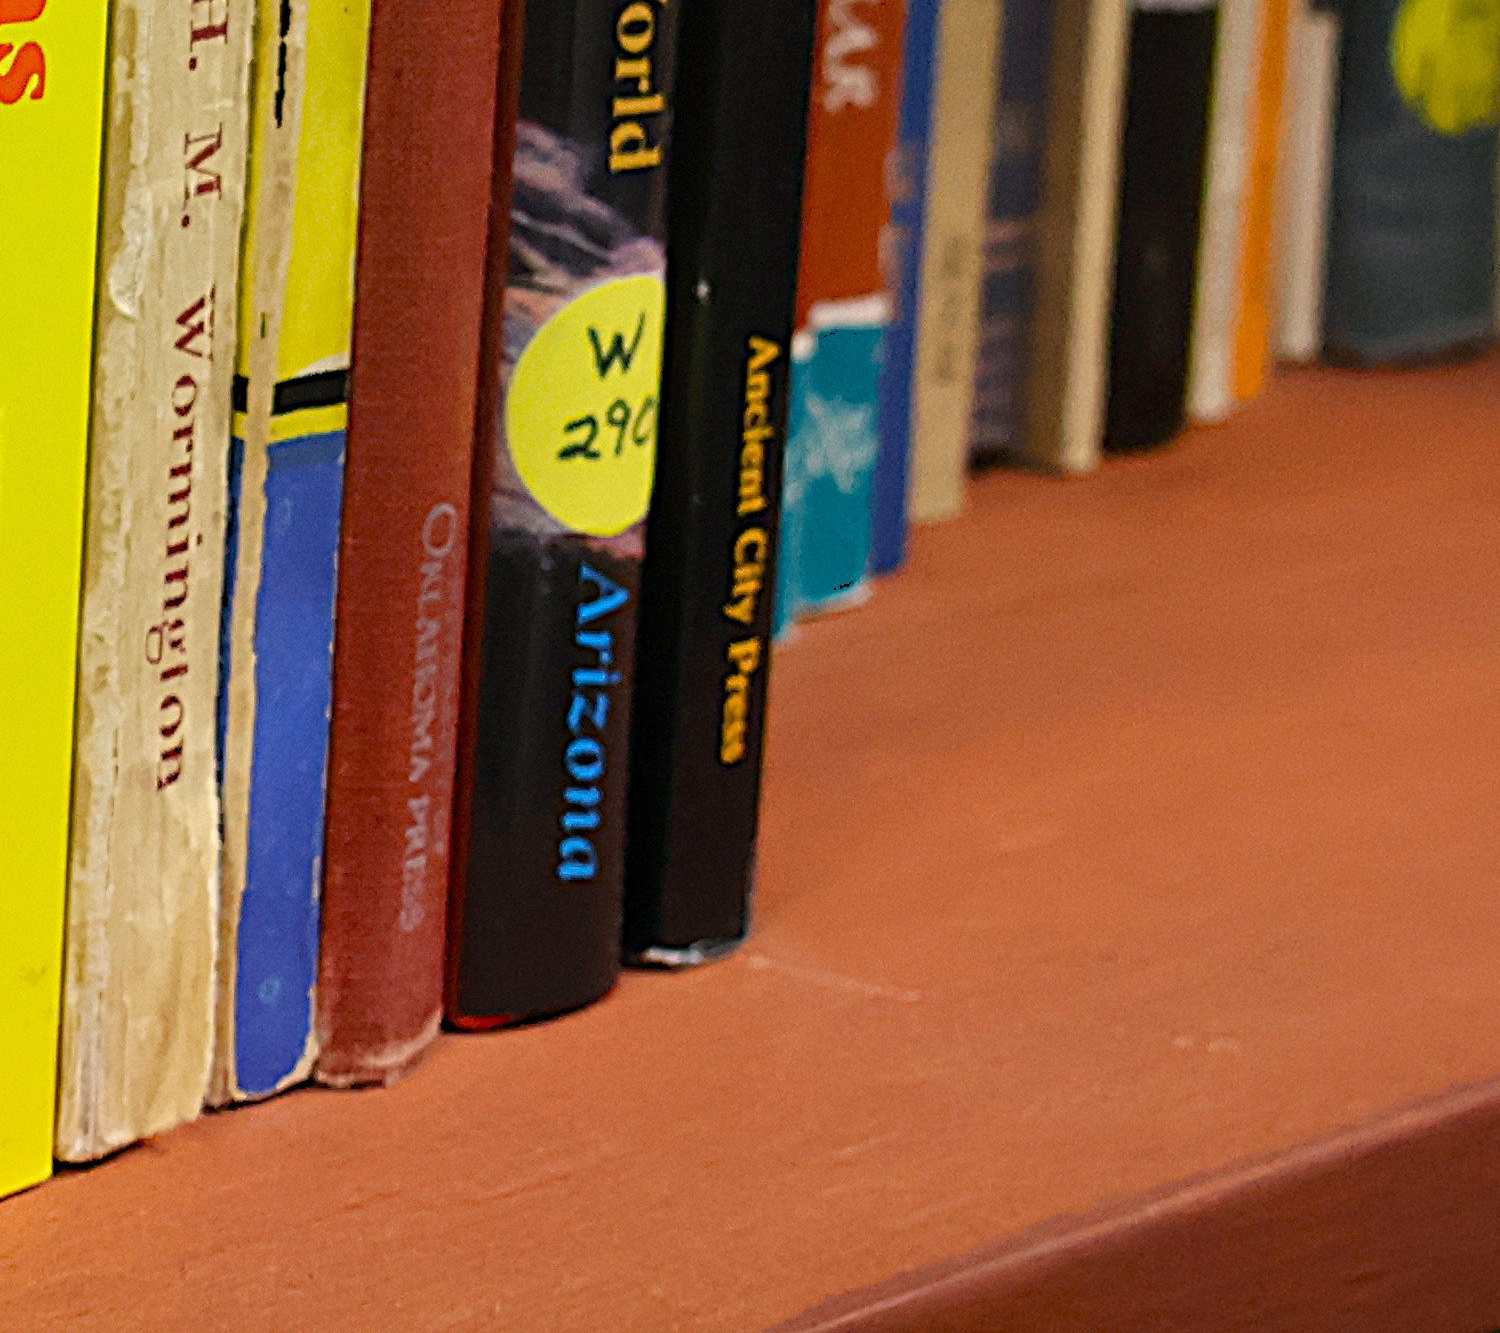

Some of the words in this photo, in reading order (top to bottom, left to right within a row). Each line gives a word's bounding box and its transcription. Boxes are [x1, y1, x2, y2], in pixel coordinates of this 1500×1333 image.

[179, 122, 222, 230] M.
[587, 311, 645, 381] W
[737, 335, 782, 520] Ancient
[144, 284, 216, 794] Wormington
[723, 524, 767, 629] City
[557, 559, 632, 883] Arizona
[720, 633, 761, 767] Press
